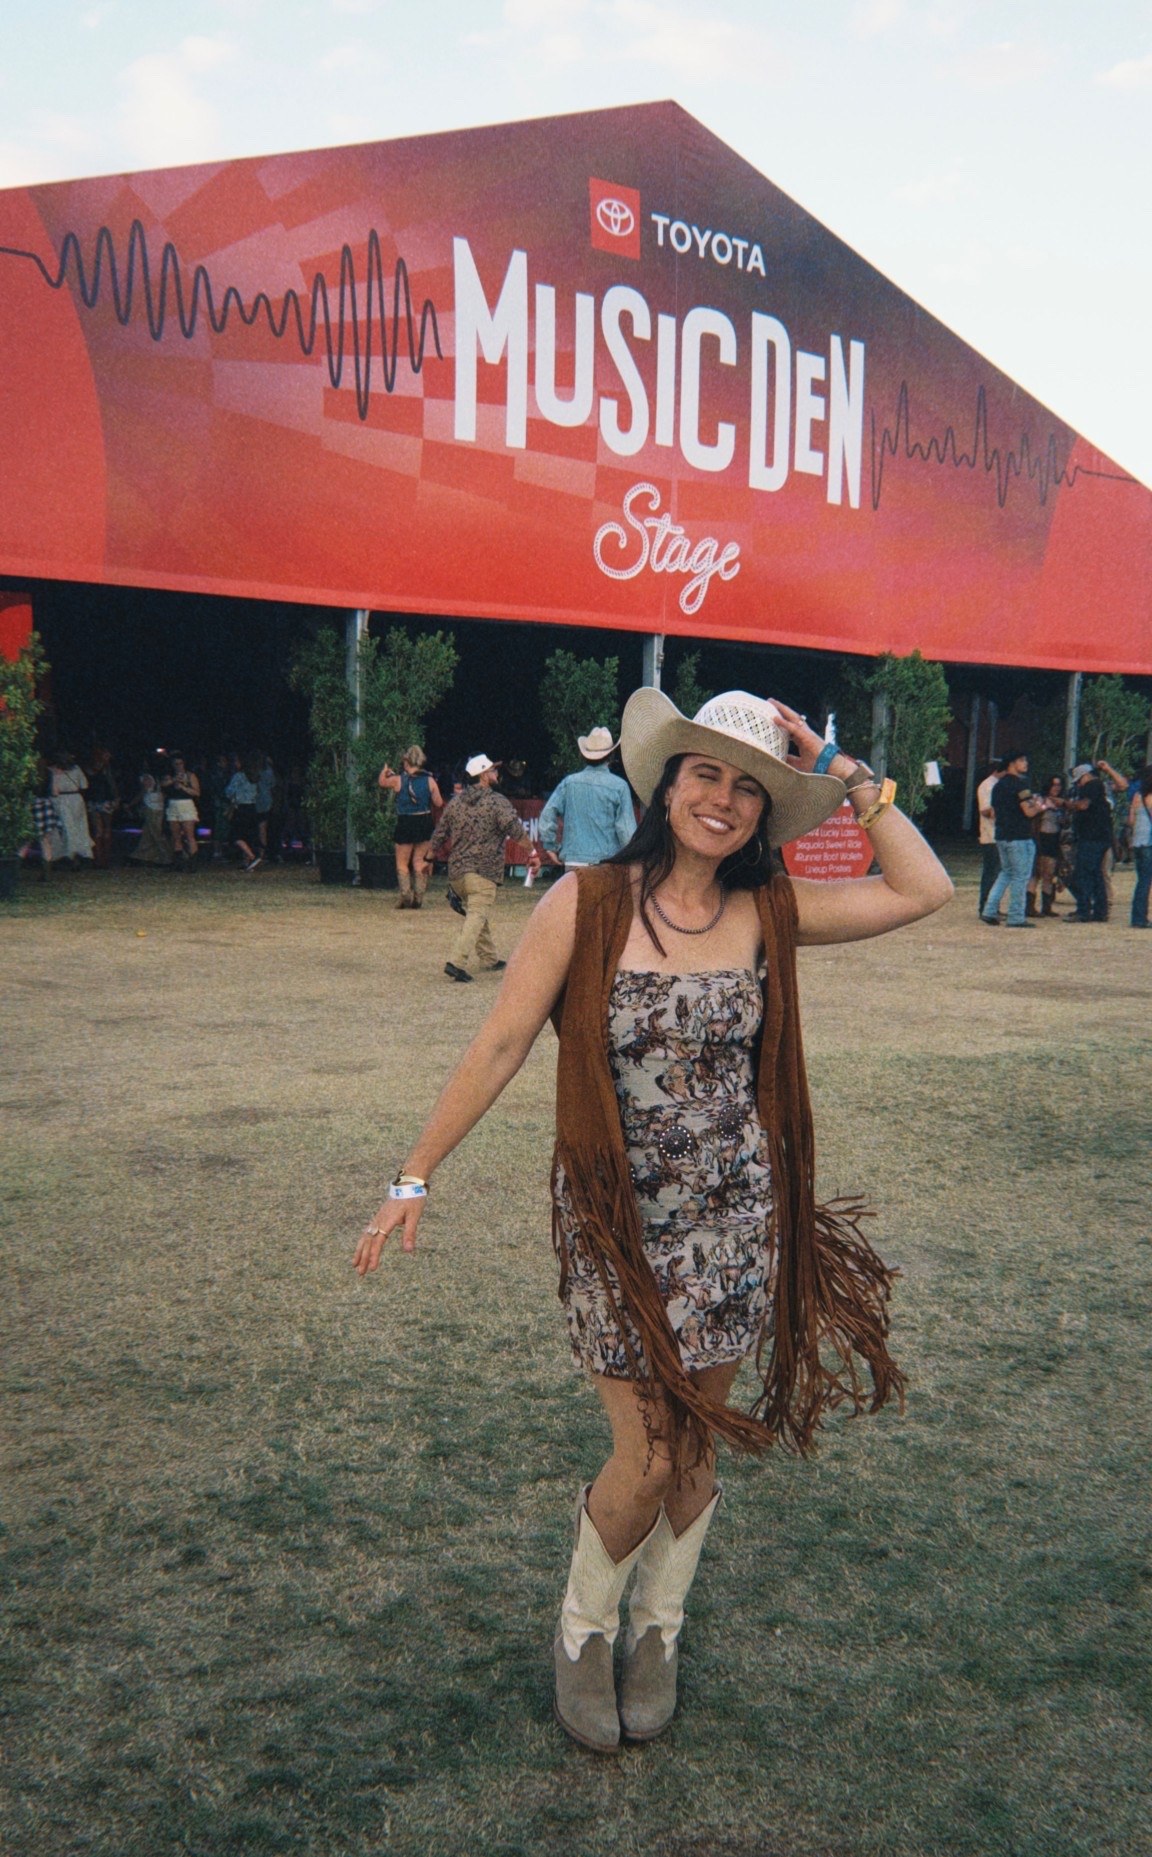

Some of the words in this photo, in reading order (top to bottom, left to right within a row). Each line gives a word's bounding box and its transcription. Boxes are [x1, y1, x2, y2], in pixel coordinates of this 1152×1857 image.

[651, 213, 766, 277] TOYOTA
[454, 236, 737, 472] MUSIC
[749, 311, 865, 510] DEN
[593, 482, 740, 616] Stage
[518, 817, 538, 842] EN
[821, 828, 839, 838] Lucky
[841, 828, 859, 836] Lasso
[796, 841, 824, 850] Sequoia
[825, 841, 846, 849] Sweet
[847, 840, 862, 848] Ride
[794, 853, 821, 861] 4Runner
[823, 852, 838, 861] Boot
[805, 865, 827, 874] Lineup
